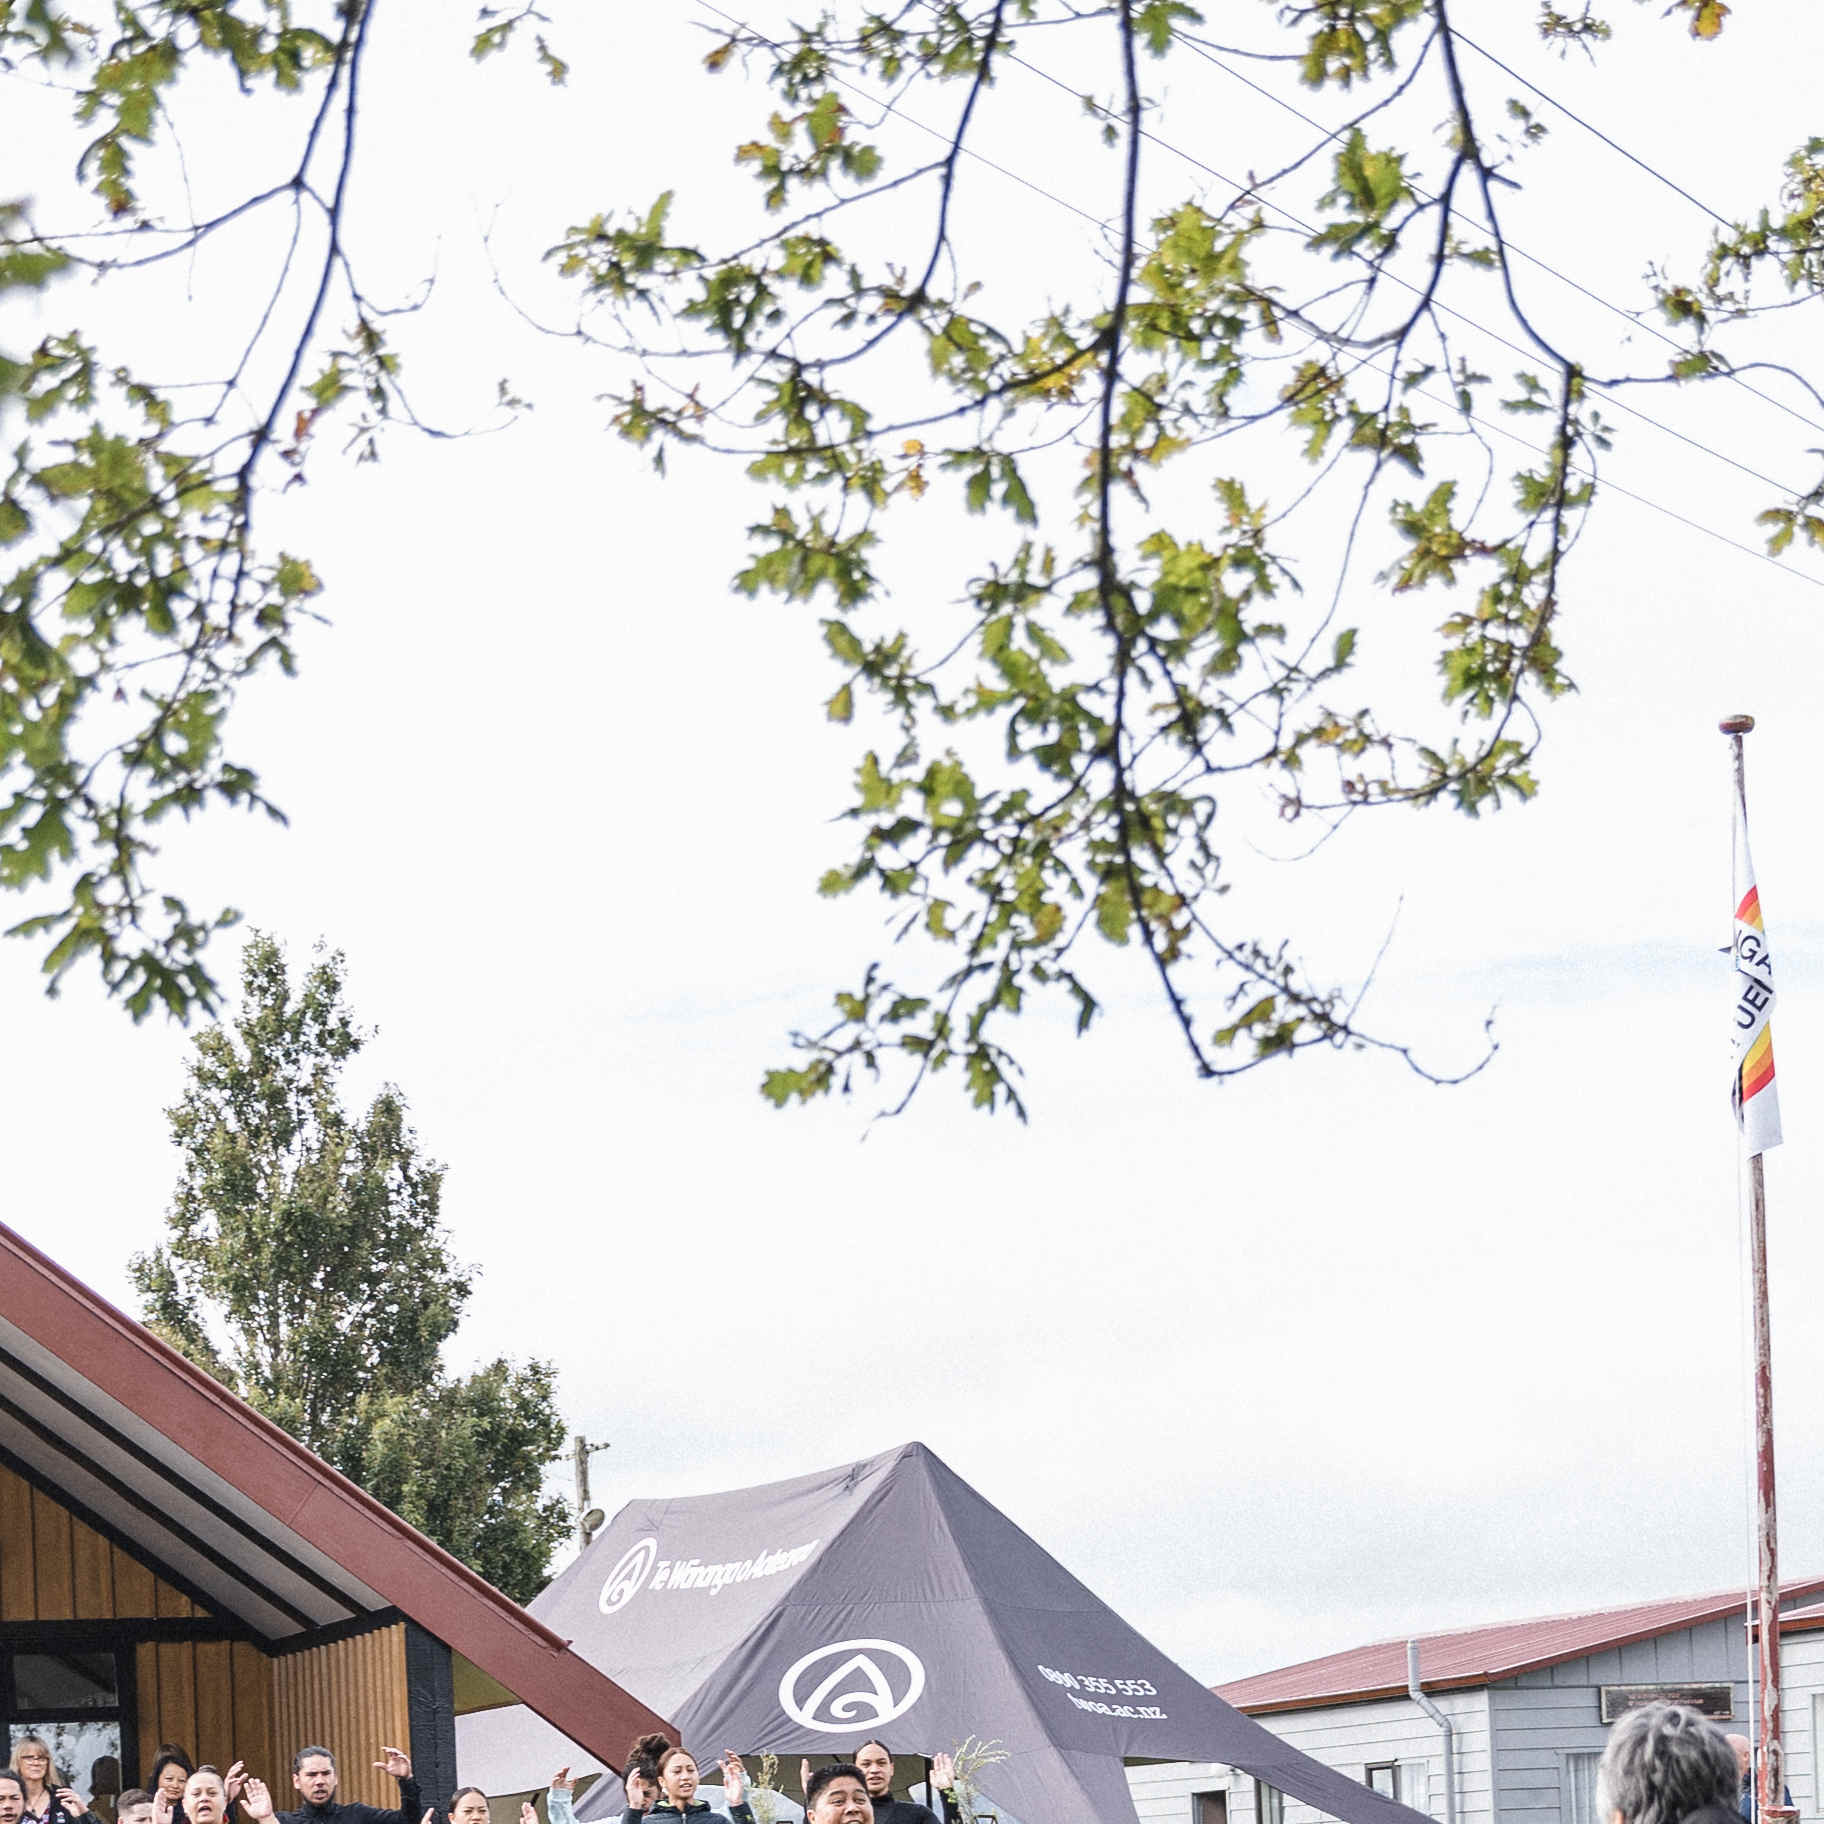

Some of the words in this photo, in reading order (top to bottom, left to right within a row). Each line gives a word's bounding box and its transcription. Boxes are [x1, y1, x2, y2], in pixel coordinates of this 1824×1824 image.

[648, 1560, 672, 1590] Te
[1076, 1675, 1117, 1695] 355
[1113, 1679, 1158, 1696] 553
